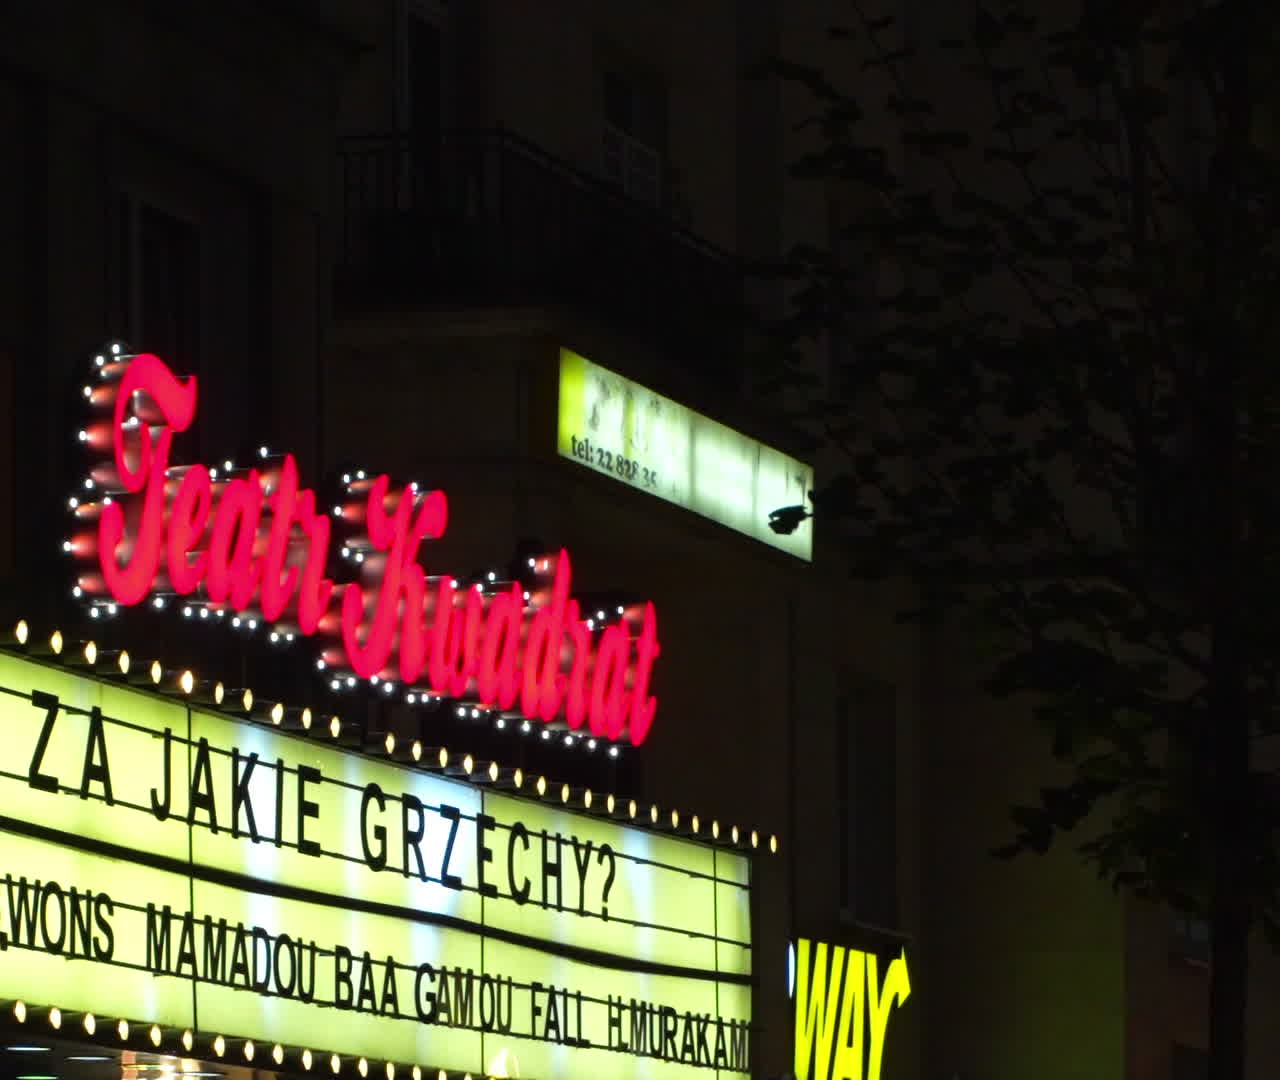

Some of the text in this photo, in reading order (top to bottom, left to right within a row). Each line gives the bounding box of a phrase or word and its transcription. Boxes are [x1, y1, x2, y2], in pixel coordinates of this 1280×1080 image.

[99, 353, 659, 747] Teatr Kwadrat
[28, 689, 616, 922] ZA JAKIE GRZECHY?
[146, 902, 316, 1004] MAMADOU
[334, 944, 401, 1020] BAA
[414, 962, 513, 1033] GAMOU
[531, 982, 590, 1049] FALL
